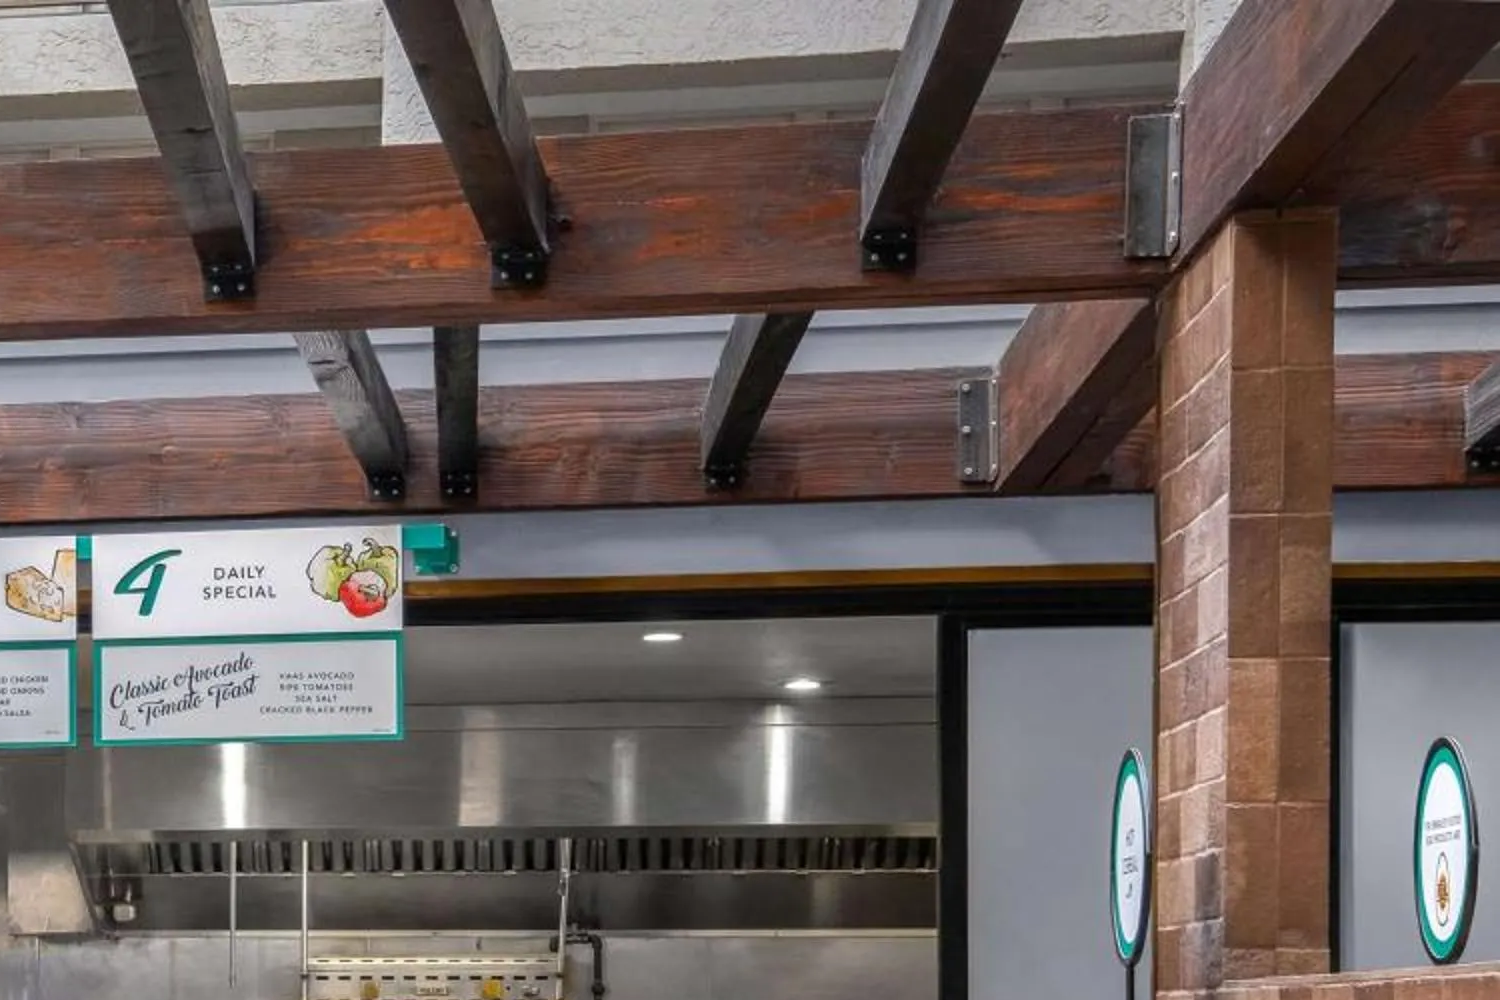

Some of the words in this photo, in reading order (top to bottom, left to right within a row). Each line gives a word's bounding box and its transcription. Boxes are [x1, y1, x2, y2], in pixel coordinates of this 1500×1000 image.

[213, 566, 265, 581] DAILY
[113, 549, 183, 617] 4
[202, 585, 277, 601] SPECIAL
[109, 673, 169, 710] Classic
[173, 651, 253, 693] Avocado
[307, 671, 355, 681] AVOCADO
[302, 683, 354, 692] TOMATOES
[138, 687, 204, 727] Tomato
[207, 674, 260, 709] Toast
[295, 694, 312, 703] SEA
[315, 694, 338, 703] SALT
[260, 705, 302, 714] CRACKED
[339, 705, 373, 714] PEPPER
